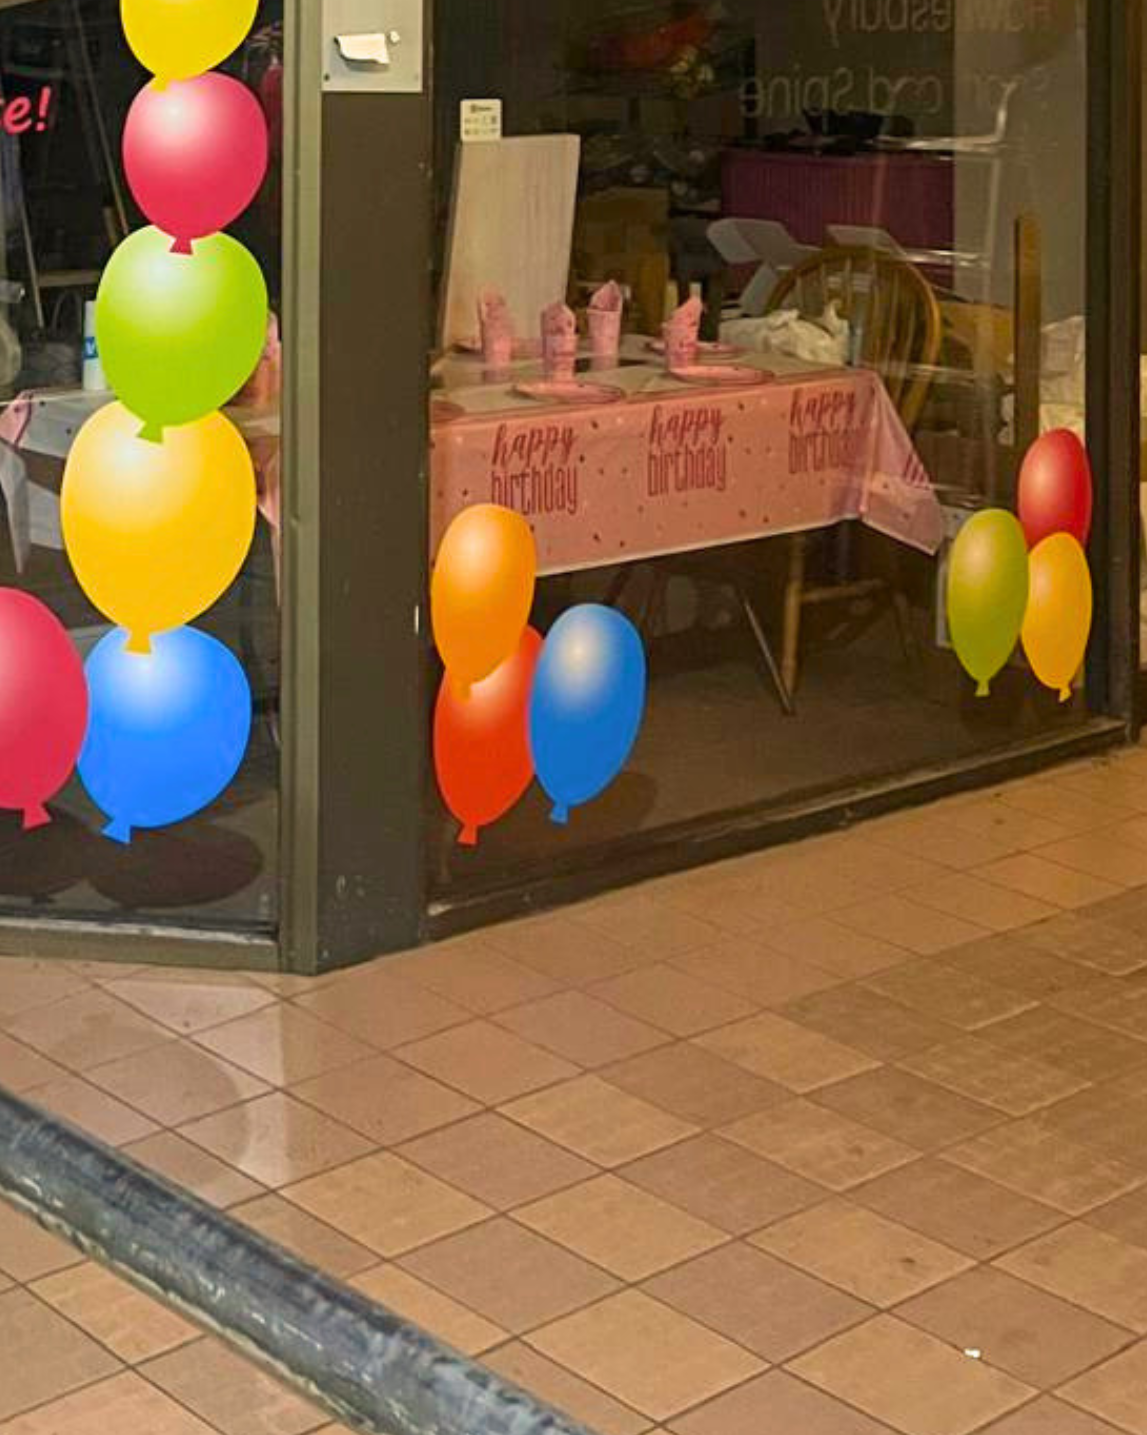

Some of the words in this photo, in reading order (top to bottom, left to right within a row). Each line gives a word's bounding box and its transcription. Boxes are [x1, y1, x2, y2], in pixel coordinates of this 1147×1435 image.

[492, 423, 578, 467] happy
[649, 404, 726, 447] happy
[491, 462, 577, 516] birthday
[648, 442, 727, 497] birthday
